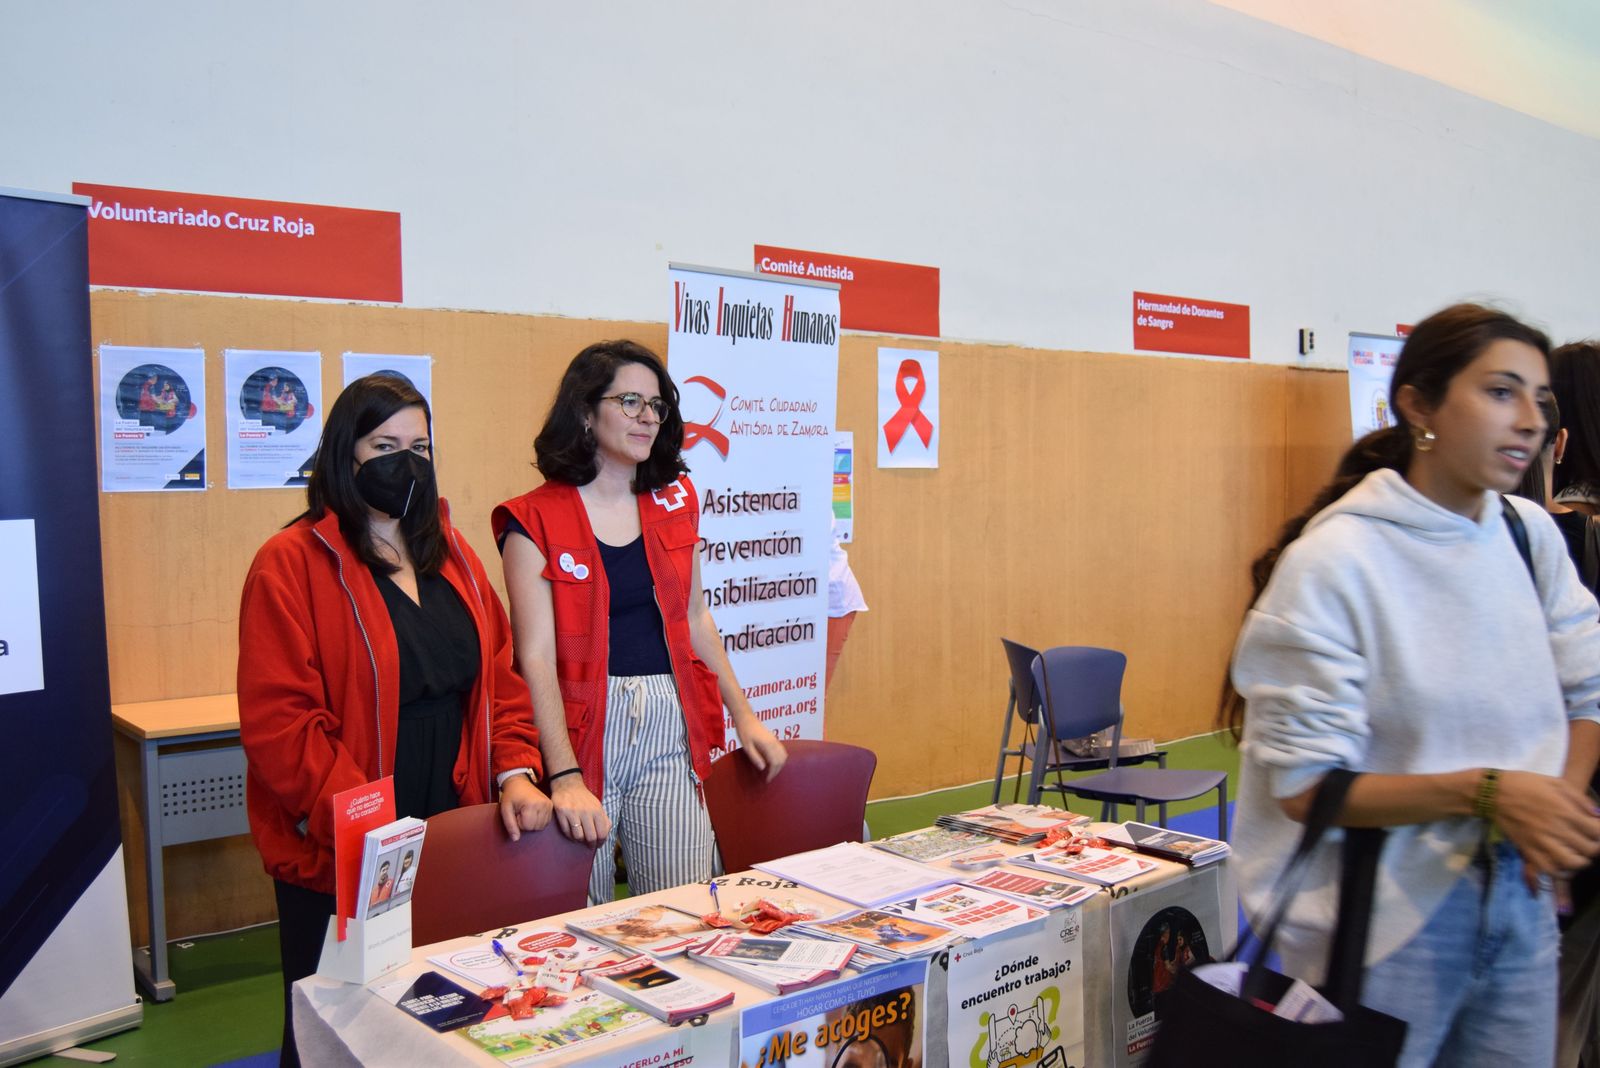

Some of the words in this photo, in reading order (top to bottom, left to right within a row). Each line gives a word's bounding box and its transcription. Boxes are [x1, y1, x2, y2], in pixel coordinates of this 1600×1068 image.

[87, 201, 221, 229] Voluntariado
[224, 211, 270, 233] Cruz
[273, 215, 315, 238] Roja
[760, 256, 805, 275] Comité
[806, 262, 854, 282] Antisida
[674, 280, 711, 336] Vivas
[716, 286, 774, 346] Inquietas
[781, 294, 837, 347] Humanas
[1137, 298, 1181, 315] Hermandad
[1181, 304, 1191, 316] de
[1191, 305, 1225, 320] Donantes
[1136, 314, 1147, 327] de
[1147, 315, 1175, 331] Sangre
[769, 397, 818, 414] CIUDADANO
[777, 424, 789, 436] DE
[791, 420, 829, 438] ZAMORA
[702, 485, 798, 515] Asistencia
[699, 530, 802, 562] Prevención
[703, 572, 817, 607] nsibilización
[718, 618, 814, 653] indicación
[784, 723, 801, 740] 82
[370, 790, 381, 800] hace
[346, 806, 356, 815] que
[356, 804, 364, 812] no
[735, 877, 799, 890] Roja
[994, 954, 1040, 982] ¿Dónde
[961, 979, 1022, 1010] encuentro
[1024, 959, 1072, 986] trabajo?
[796, 1002, 823, 1018] HOGAR
[824, 996, 847, 1010] COMO
[848, 993, 855, 1002] EL
[857, 985, 876, 999] TUYO
[754, 1030, 808, 1068] ¿Me
[815, 991, 913, 1048] acoges?
[1128, 1022, 1135, 1031] La
[1135, 1015, 1153, 1027] Fuerza
[663, 1051, 670, 1061] A
[672, 1045, 684, 1057] MÍ
